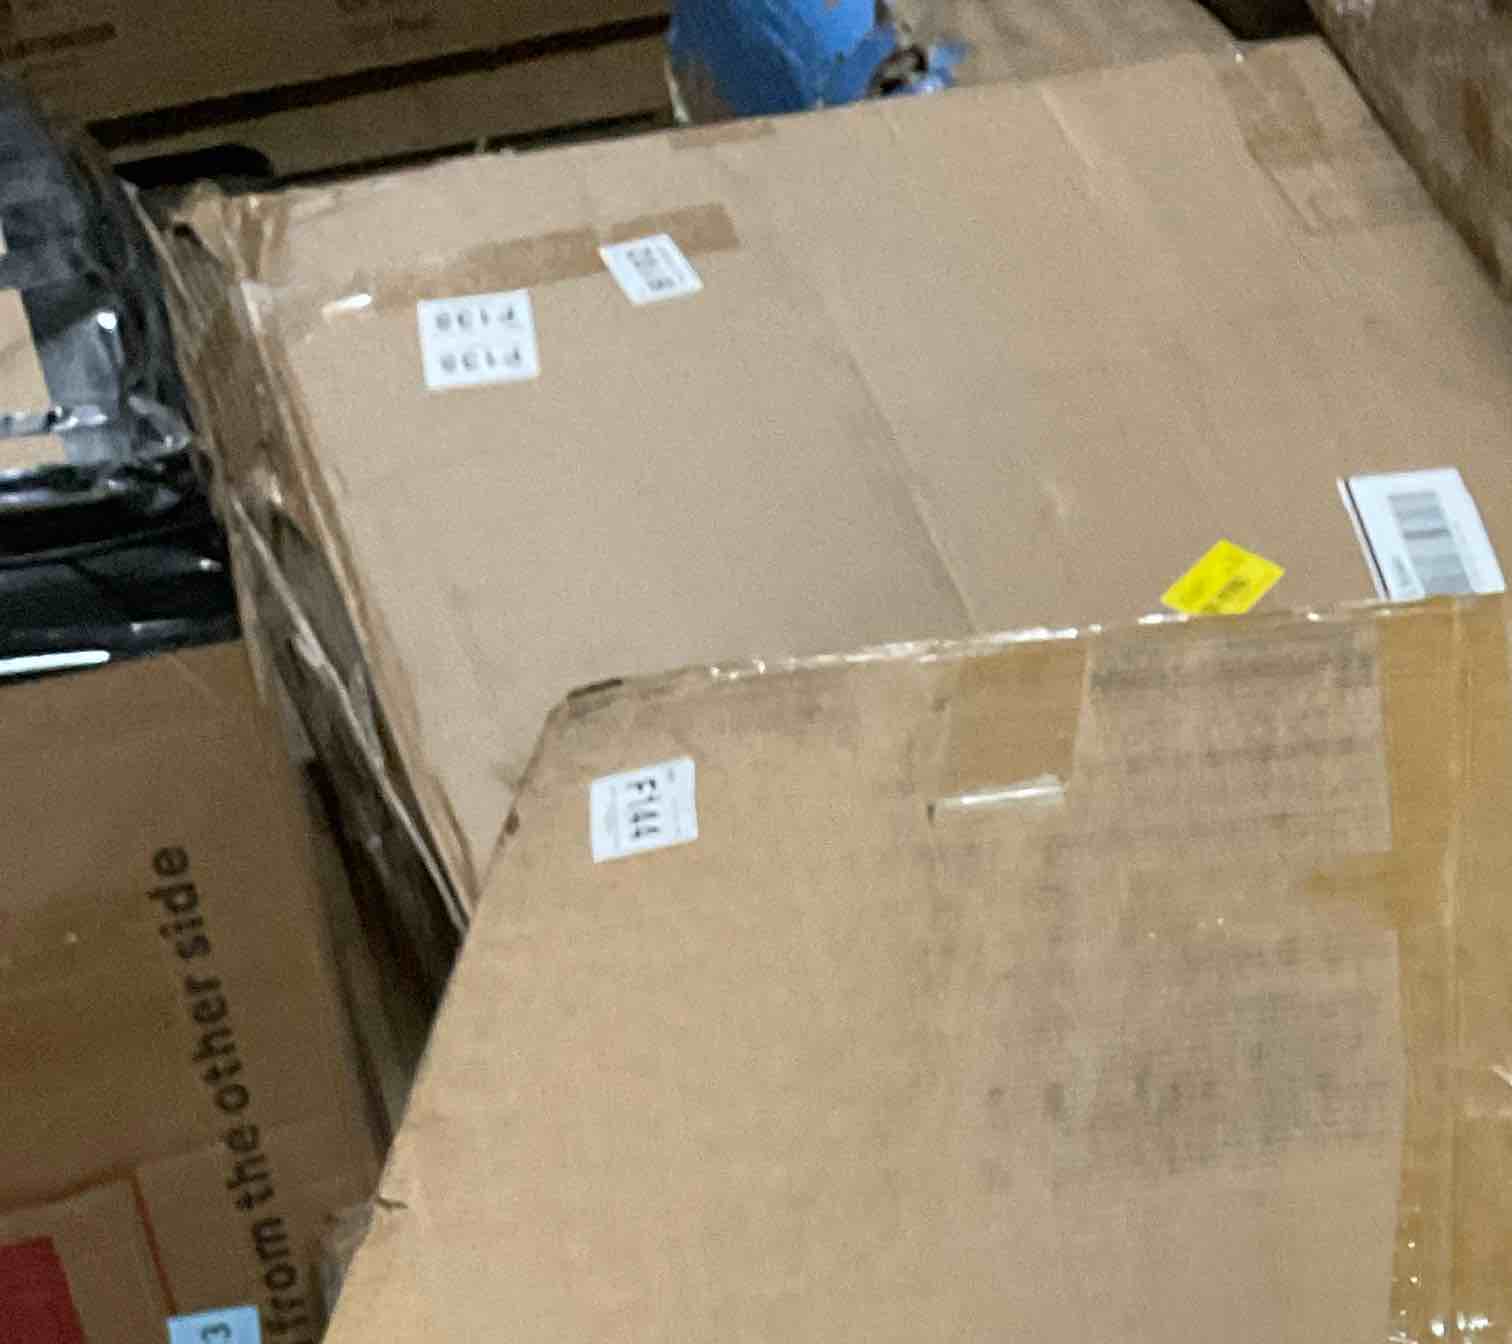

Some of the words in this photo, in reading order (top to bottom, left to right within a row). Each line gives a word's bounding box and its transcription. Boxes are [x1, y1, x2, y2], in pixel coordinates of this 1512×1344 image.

[152, 845, 210, 961] side
[185, 976, 250, 1115] other
[224, 1122, 275, 1211] the
[250, 1216, 309, 1336] from
